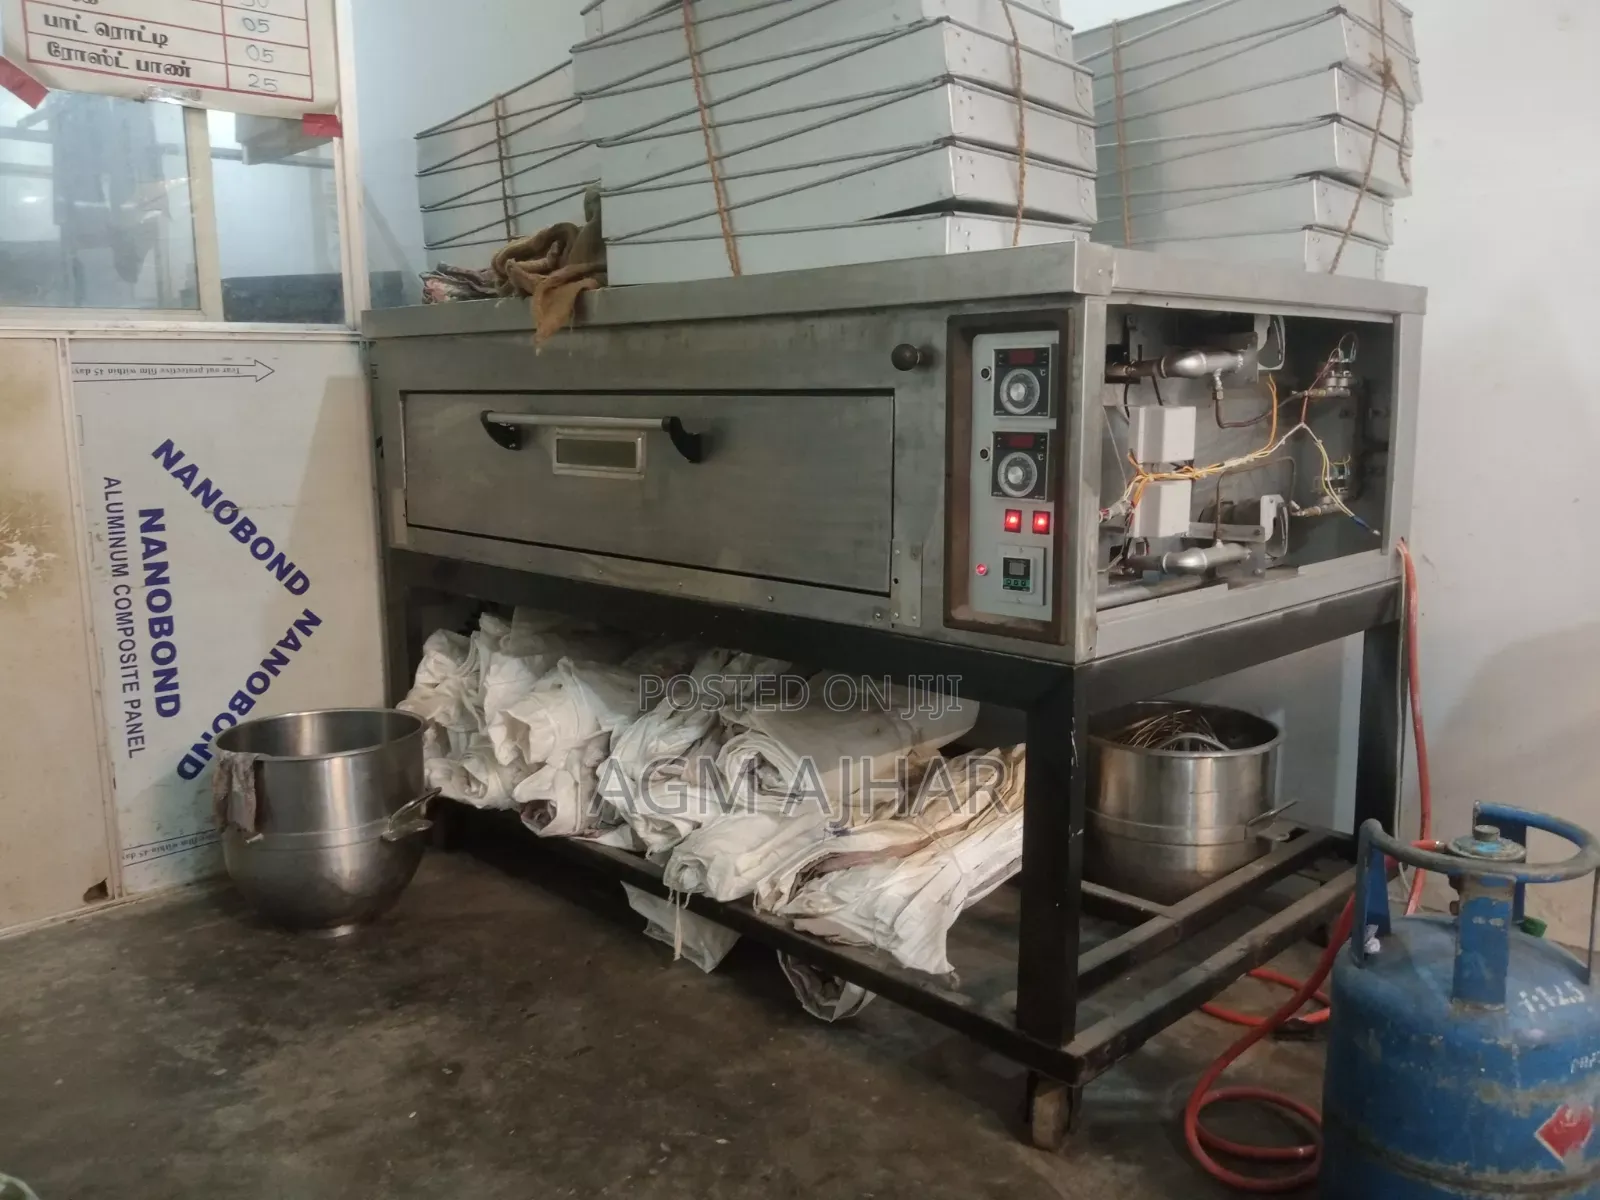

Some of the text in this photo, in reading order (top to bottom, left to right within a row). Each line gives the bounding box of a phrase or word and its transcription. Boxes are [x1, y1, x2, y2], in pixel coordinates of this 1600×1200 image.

[44, 14, 168, 48] பாட் ரொட்டி
[242, 17, 271, 33] 05
[46, 41, 192, 78] ரோஸ்ட் பாண்
[246, 44, 275, 63] 05
[248, 73, 278, 92] 25
[108, 367, 137, 376] within
[140, 367, 158, 375] film
[160, 366, 204, 376] protective
[222, 367, 240, 375] Tear
[151, 438, 311, 597] NANOBOND
[103, 476, 146, 759] ALUMINUM COMPOSITE PANEL
[138, 507, 181, 719] NANOBOND
[176, 608, 323, 781] NANOBOND
